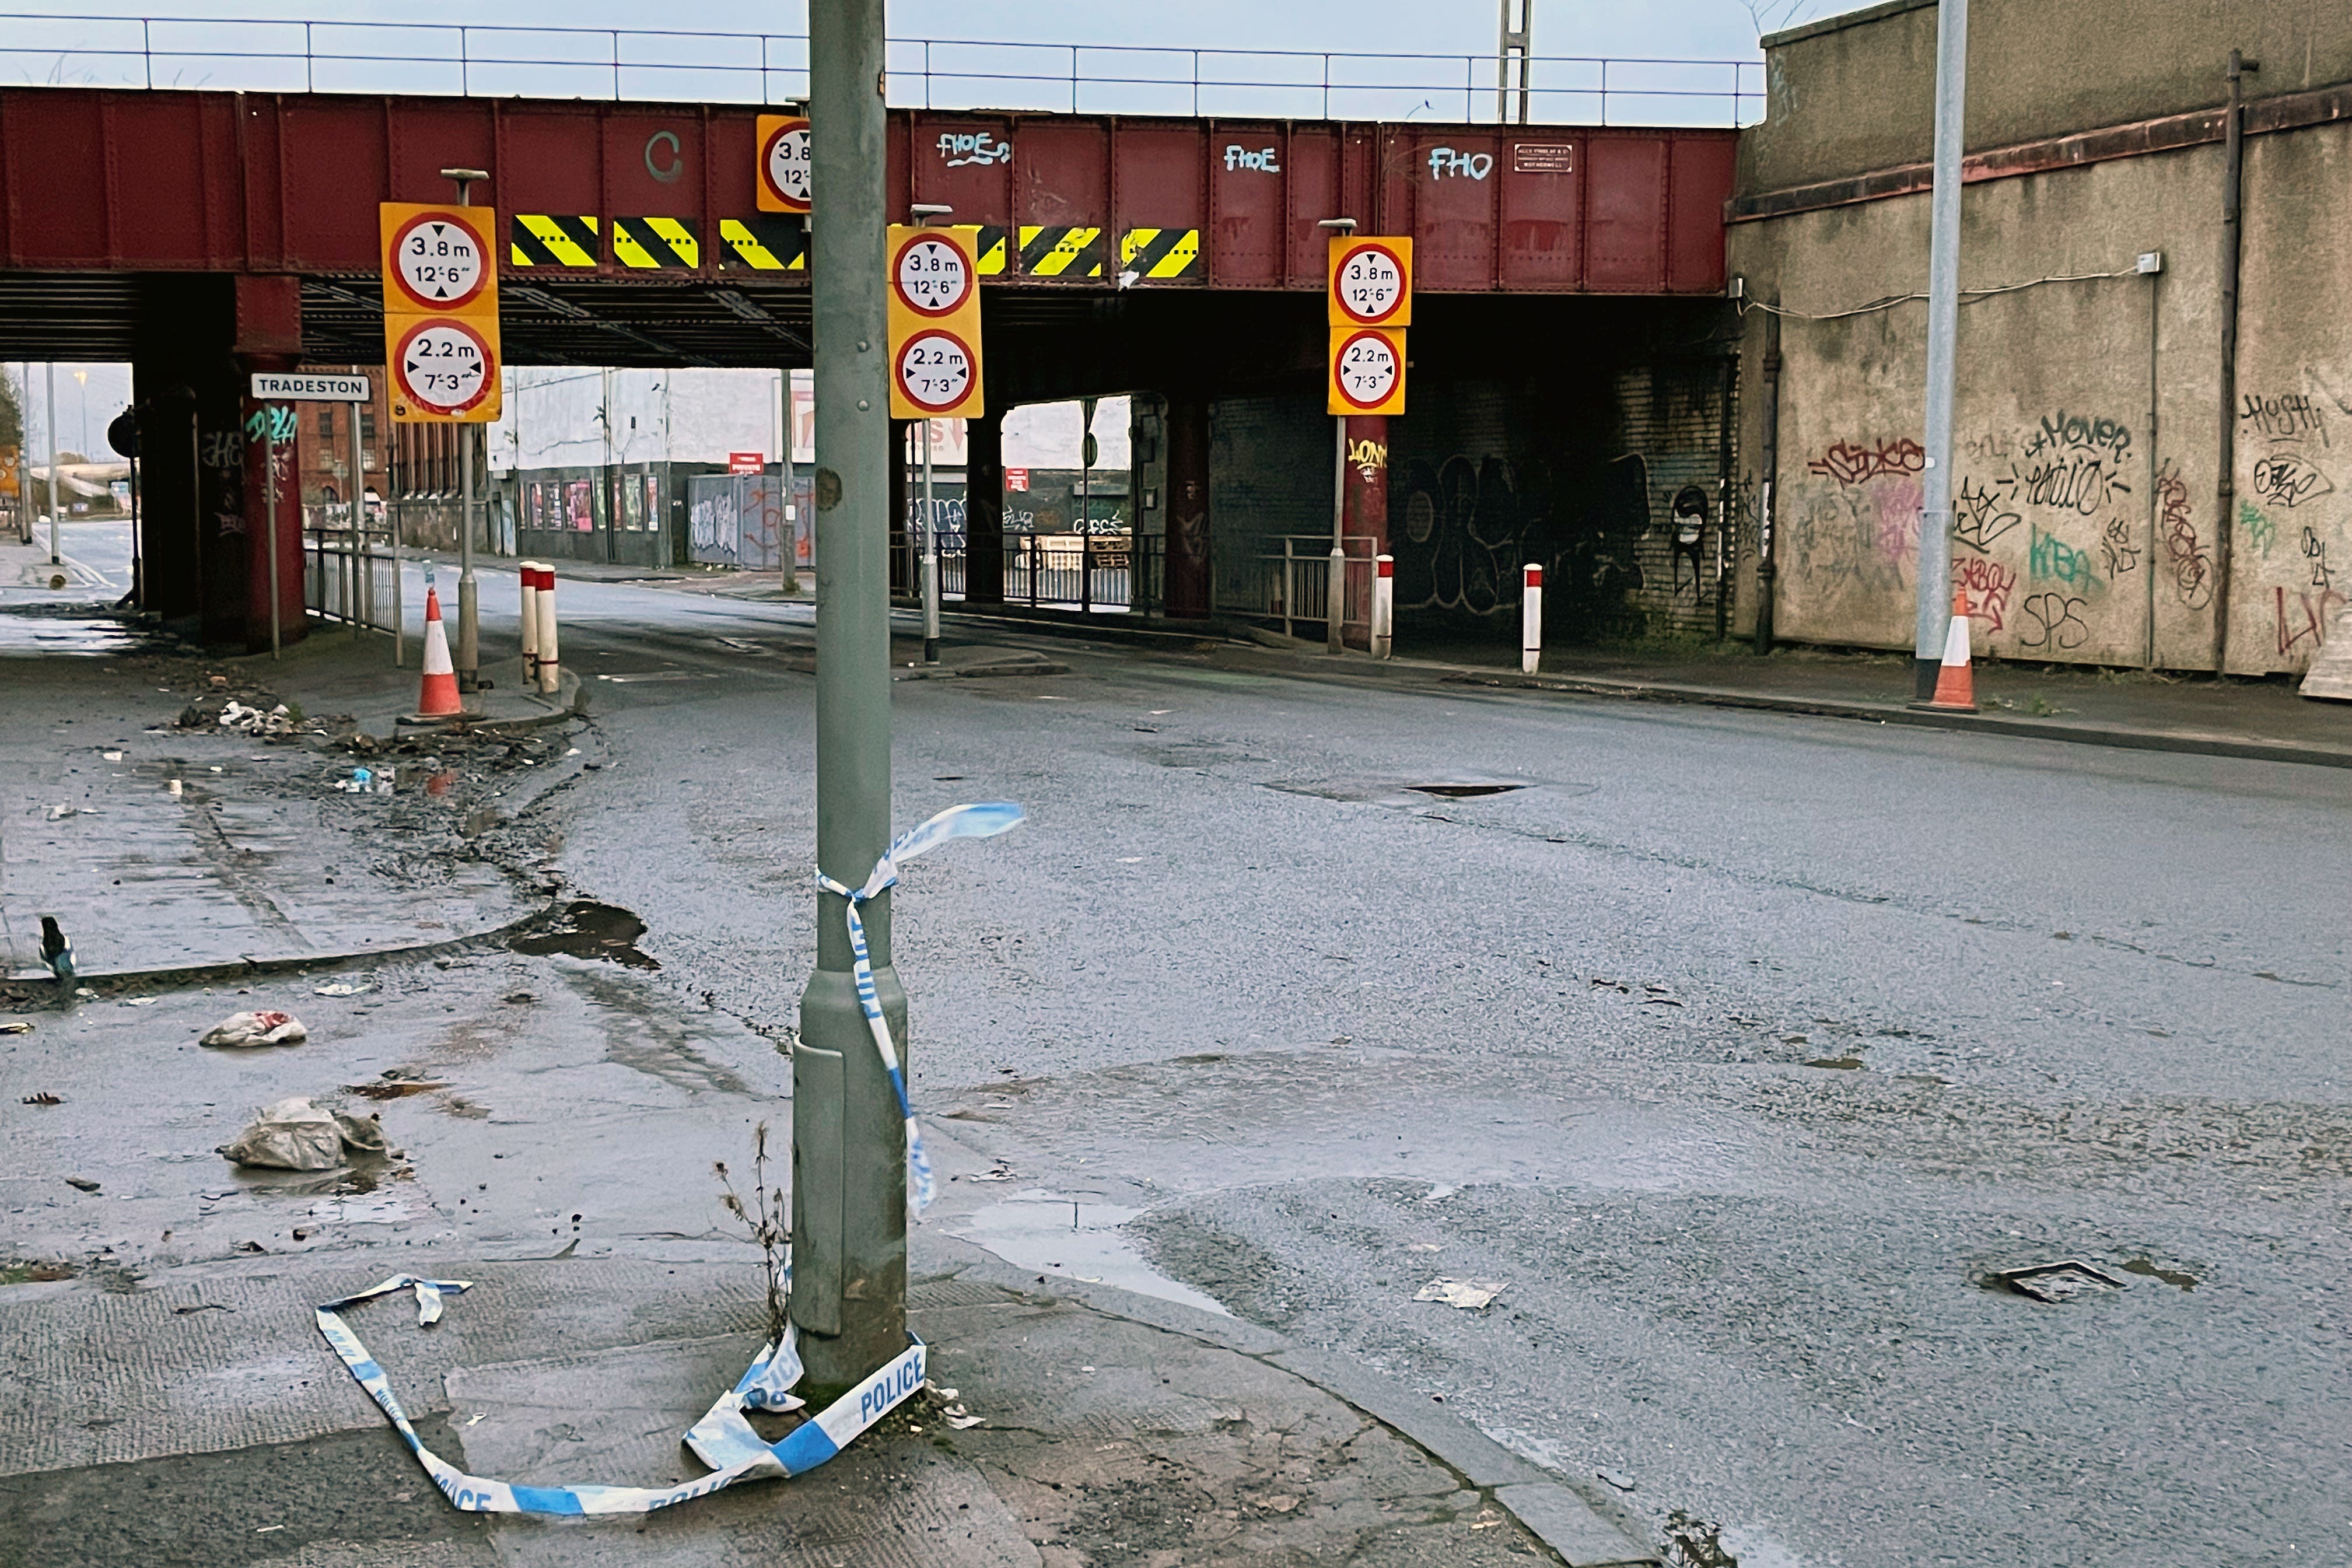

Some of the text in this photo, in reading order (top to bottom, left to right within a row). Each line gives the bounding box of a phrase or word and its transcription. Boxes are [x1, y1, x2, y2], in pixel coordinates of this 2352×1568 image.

[259, 380, 362, 393] TRADESTON
[2021, 592, 2089, 653] SPS
[861, 1352, 924, 1423] POLICE
